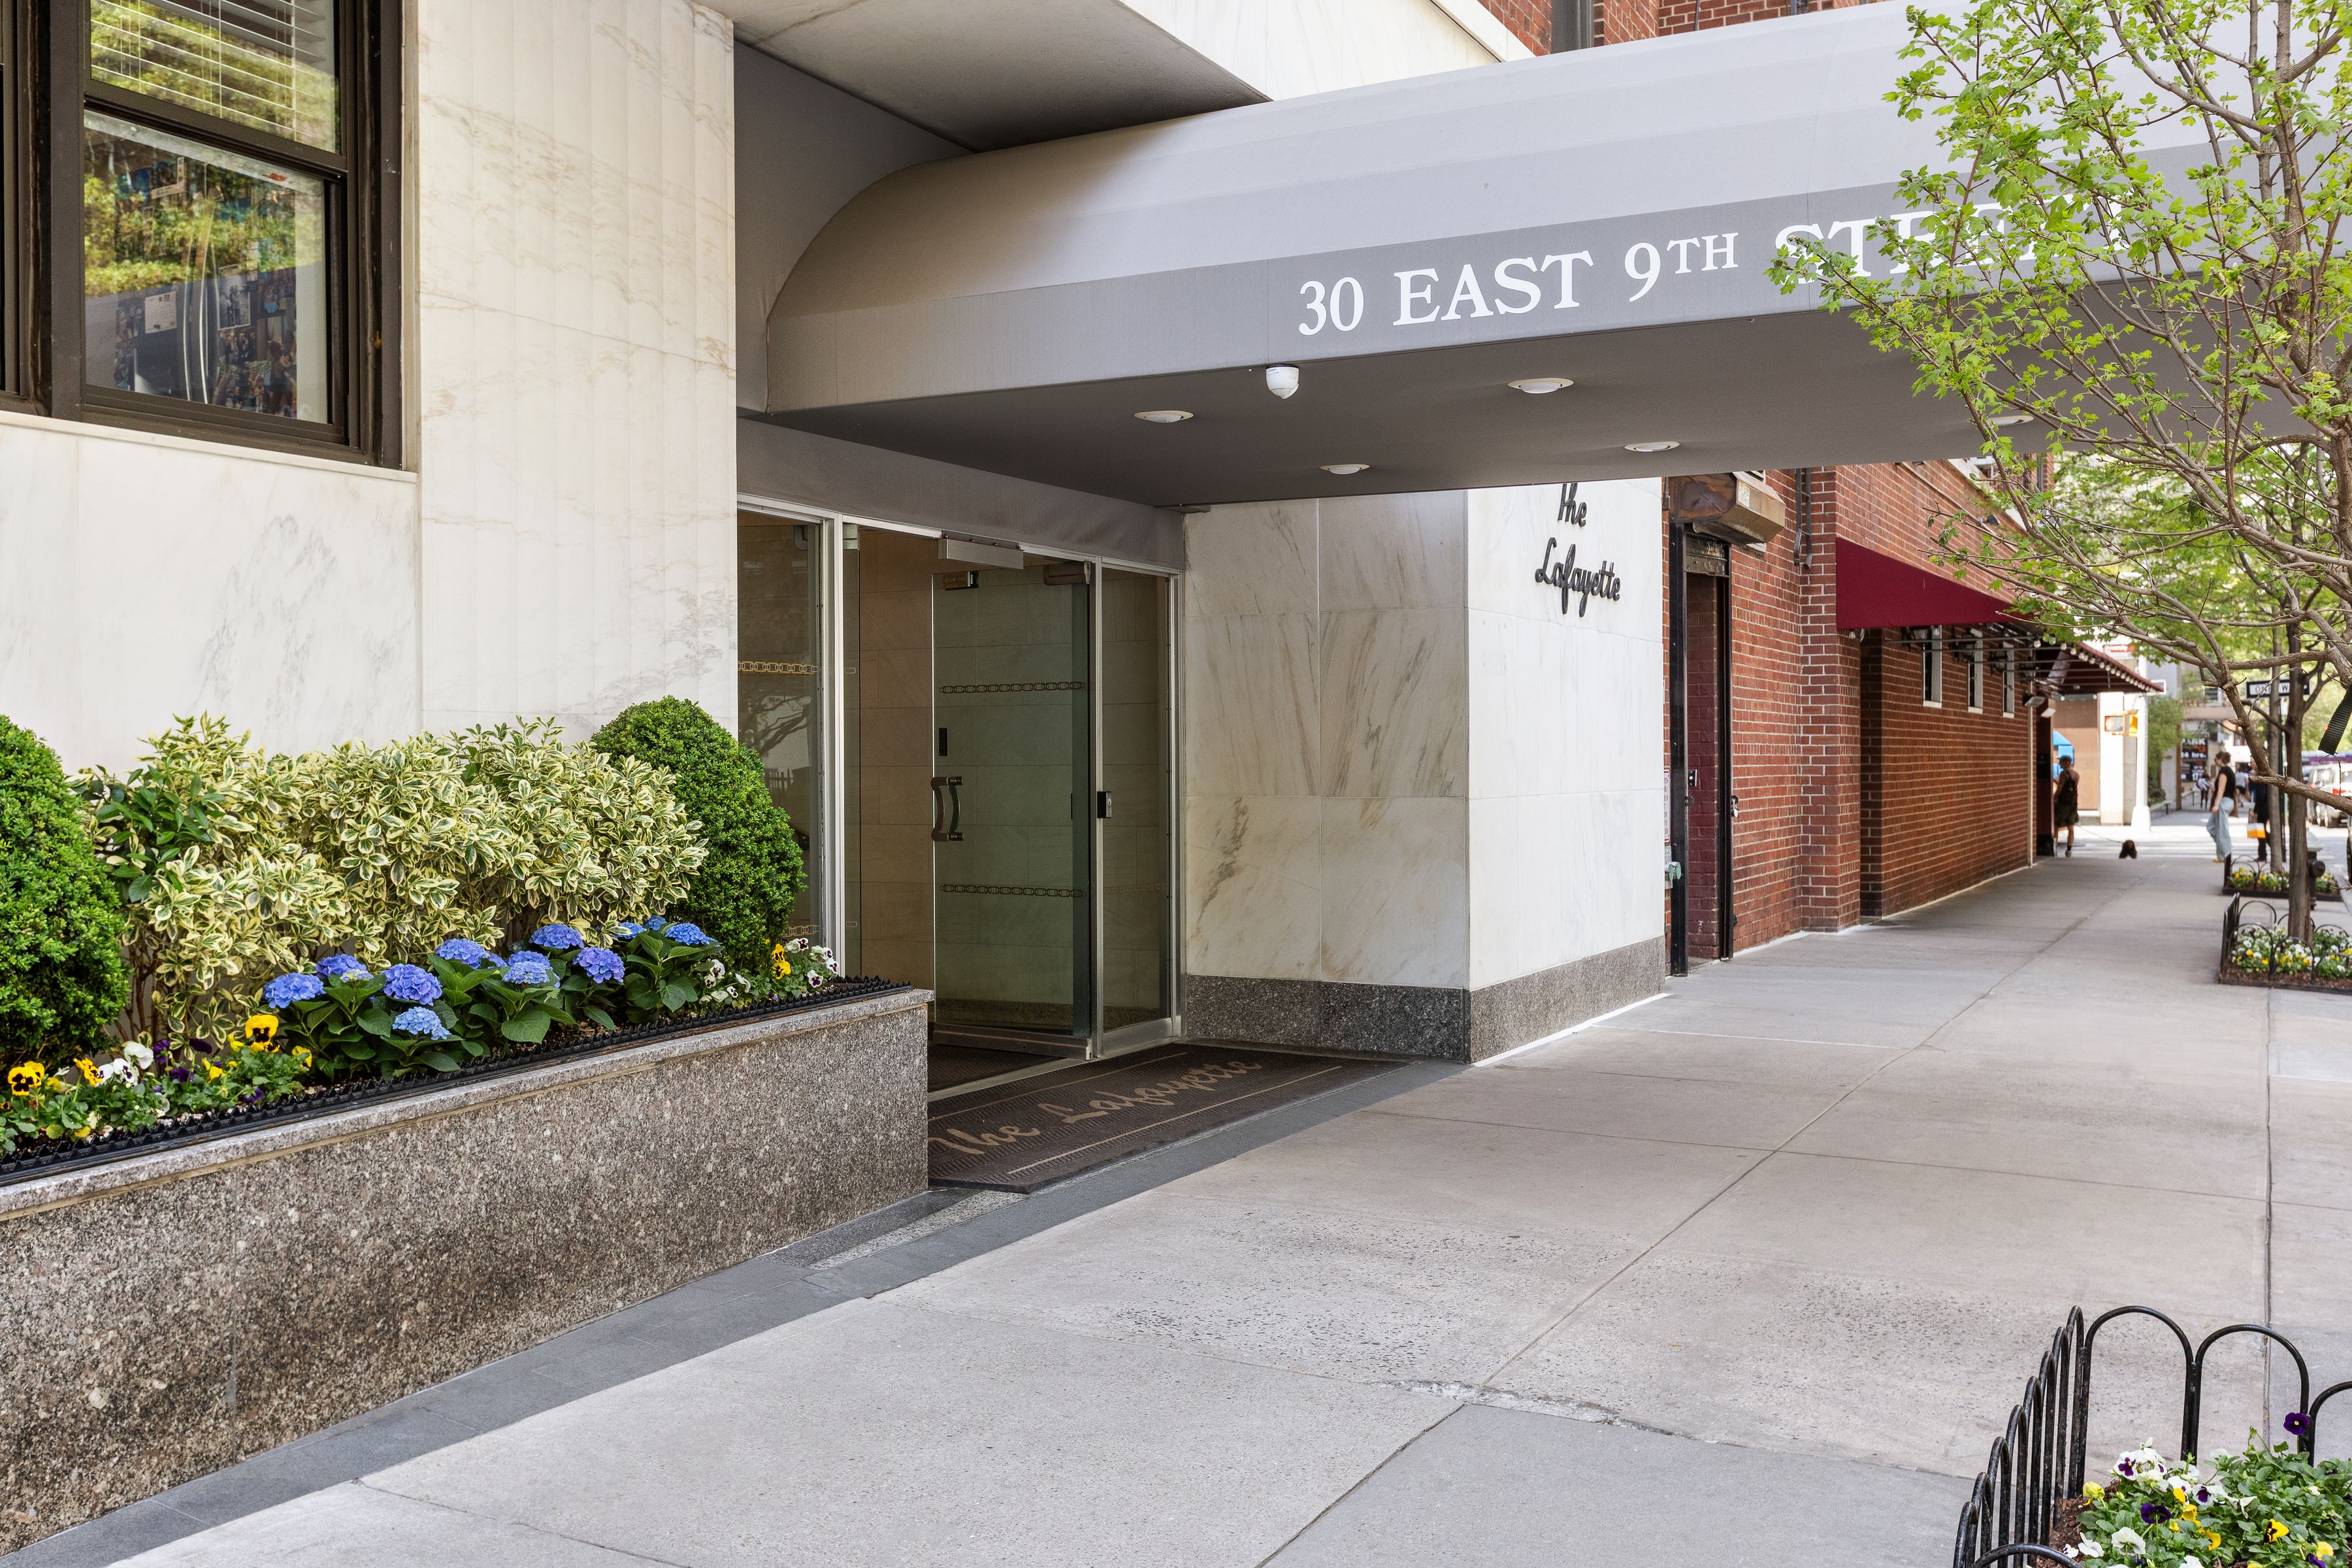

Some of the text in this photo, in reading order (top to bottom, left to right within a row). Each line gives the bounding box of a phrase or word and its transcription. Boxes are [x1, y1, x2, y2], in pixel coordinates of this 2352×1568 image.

[1298, 276, 1364, 336] 30
[1392, 250, 1594, 326] EAST
[1624, 232, 1739, 302] 9TH
[1535, 537, 1621, 617] Lafayette
[1037, 1060, 1263, 1124] Lafayette
